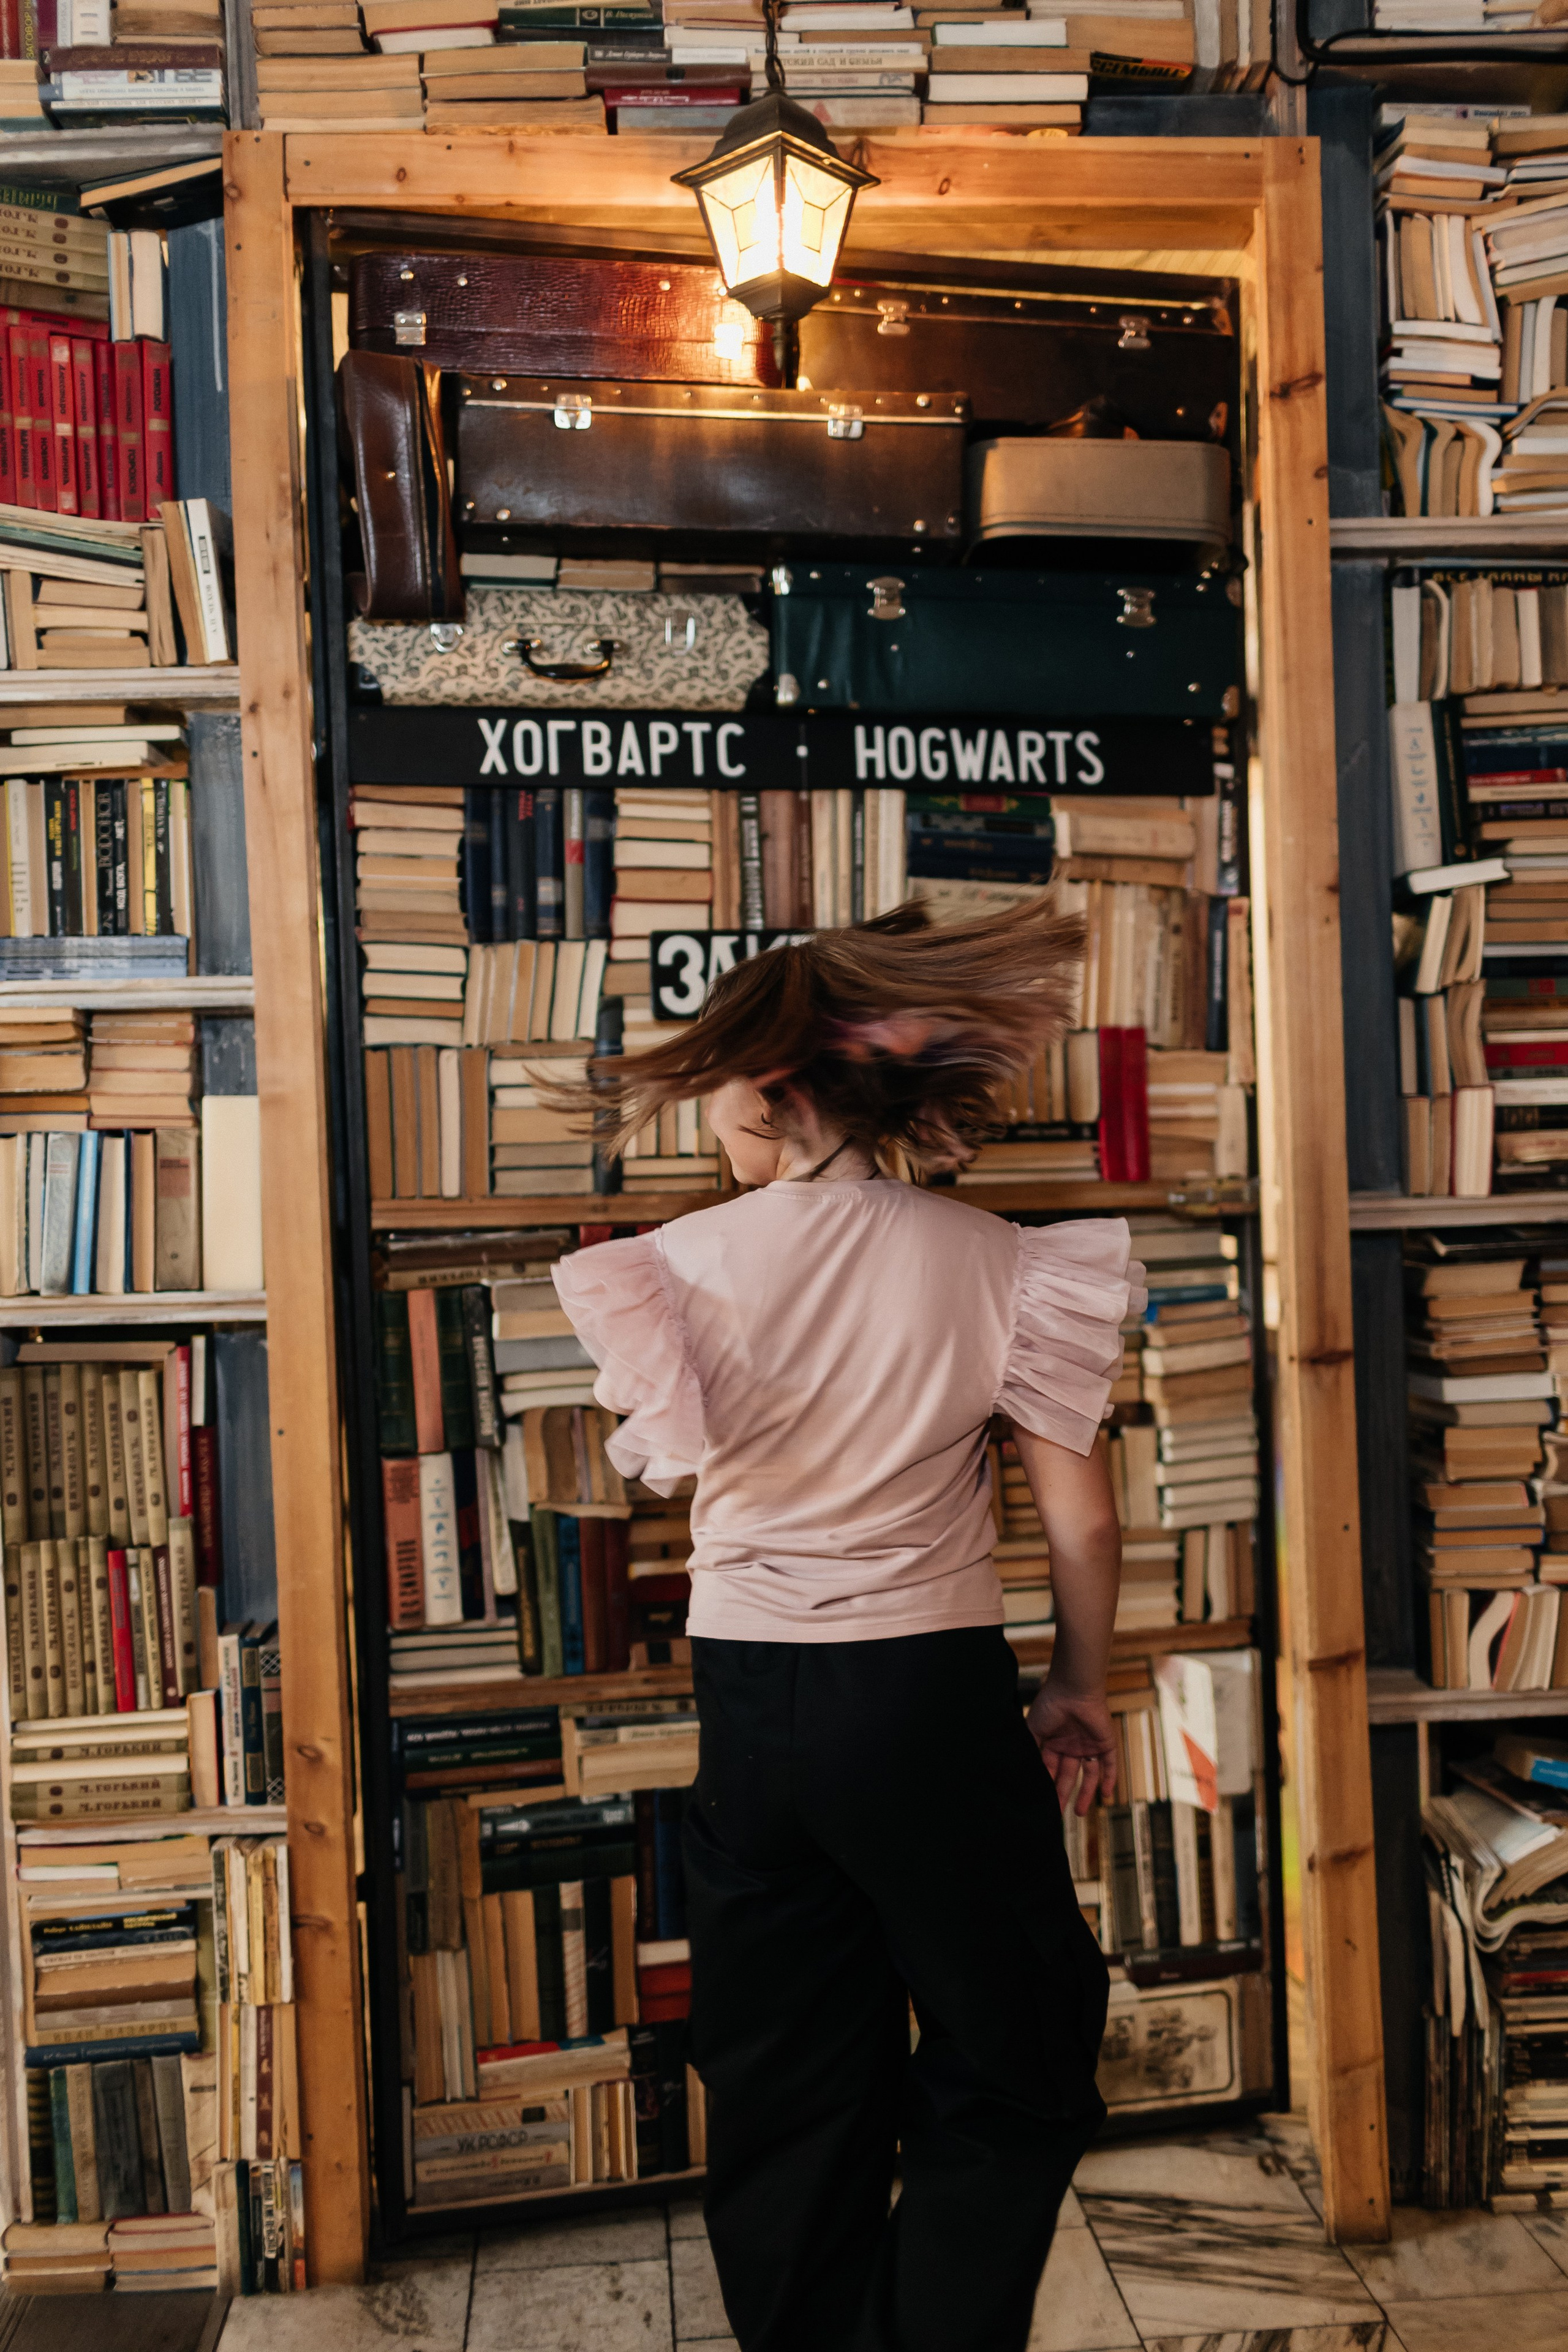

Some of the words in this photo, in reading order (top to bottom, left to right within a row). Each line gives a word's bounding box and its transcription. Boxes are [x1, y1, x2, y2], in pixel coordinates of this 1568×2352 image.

[24, 12, 34, 58] ЗАГОВОР
[780, 57, 815, 66] ТСКИЙ
[817, 58, 837, 67] САД
[477, 718, 745, 777] ХОГВАРТС
[855, 725, 1104, 784] HOGWARTS
[478, 2130, 529, 2150] РСФСР
